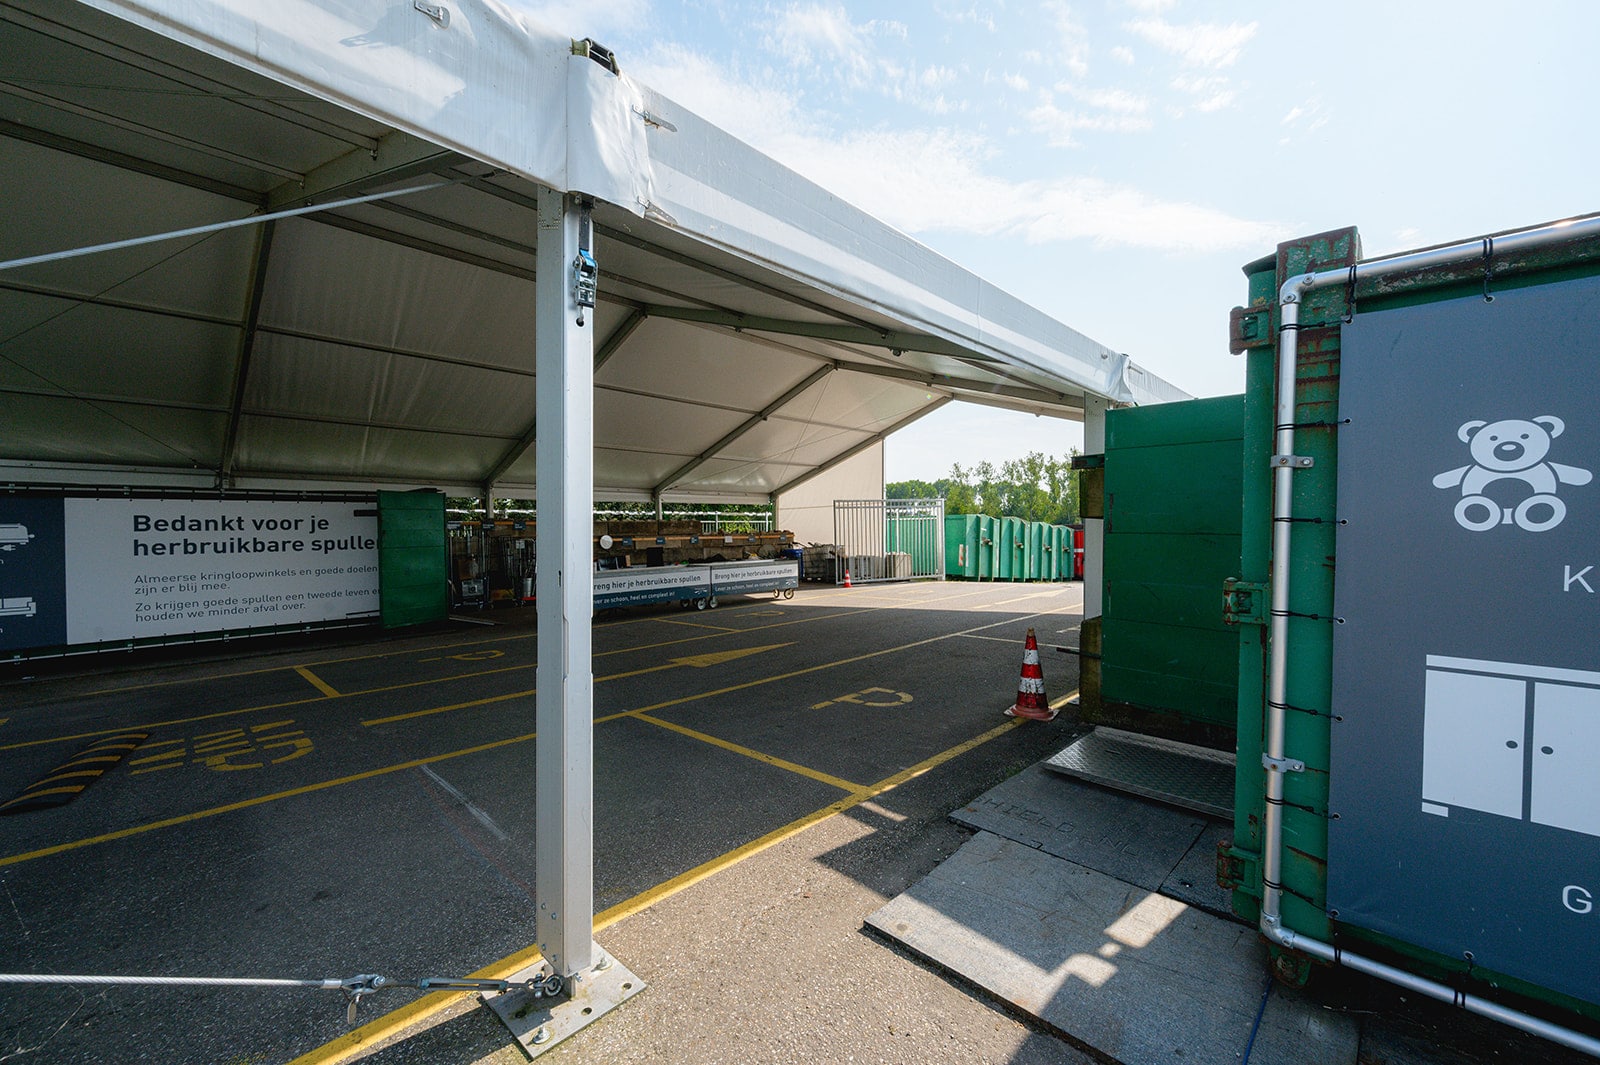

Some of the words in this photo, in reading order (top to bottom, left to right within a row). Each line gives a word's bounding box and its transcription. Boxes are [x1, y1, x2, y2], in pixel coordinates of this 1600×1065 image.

[133, 515, 245, 532] Bedankt
[252, 518, 305, 531] voor
[309, 515, 330, 534] je
[133, 536, 305, 556] herbruikbare
[311, 535, 379, 554] spulle
[134, 574, 197, 584] Almeerse
[200, 568, 297, 581] kringloopwinkels
[299, 568, 312, 576] en
[314, 566, 345, 577] goede
[346, 565, 379, 574] doelen
[593, 583, 611, 591] reng
[612, 581, 626, 589] hier
[627, 581, 635, 589] je
[635, 578, 678, 586] herbruikbare
[679, 575, 702, 583] spullen
[1562, 564, 1596, 594] K
[134, 585, 158, 596] zijn
[161, 585, 175, 593] er
[179, 583, 198, 594] blij
[201, 582, 231, 591] mee.
[135, 602, 152, 612] Zo
[155, 600, 200, 611] krijgen
[203, 597, 239, 609] goede
[241, 594, 282, 605] spullen
[285, 593, 304, 601] een
[307, 590, 343, 599] tweede
[345, 589, 370, 597] leven
[135, 611, 184, 622] houden
[187, 610, 205, 618] we
[208, 605, 250, 616] minder
[253, 603, 280, 613] afval
[282, 602, 306, 611] over.
[1561, 885, 1593, 914] G
